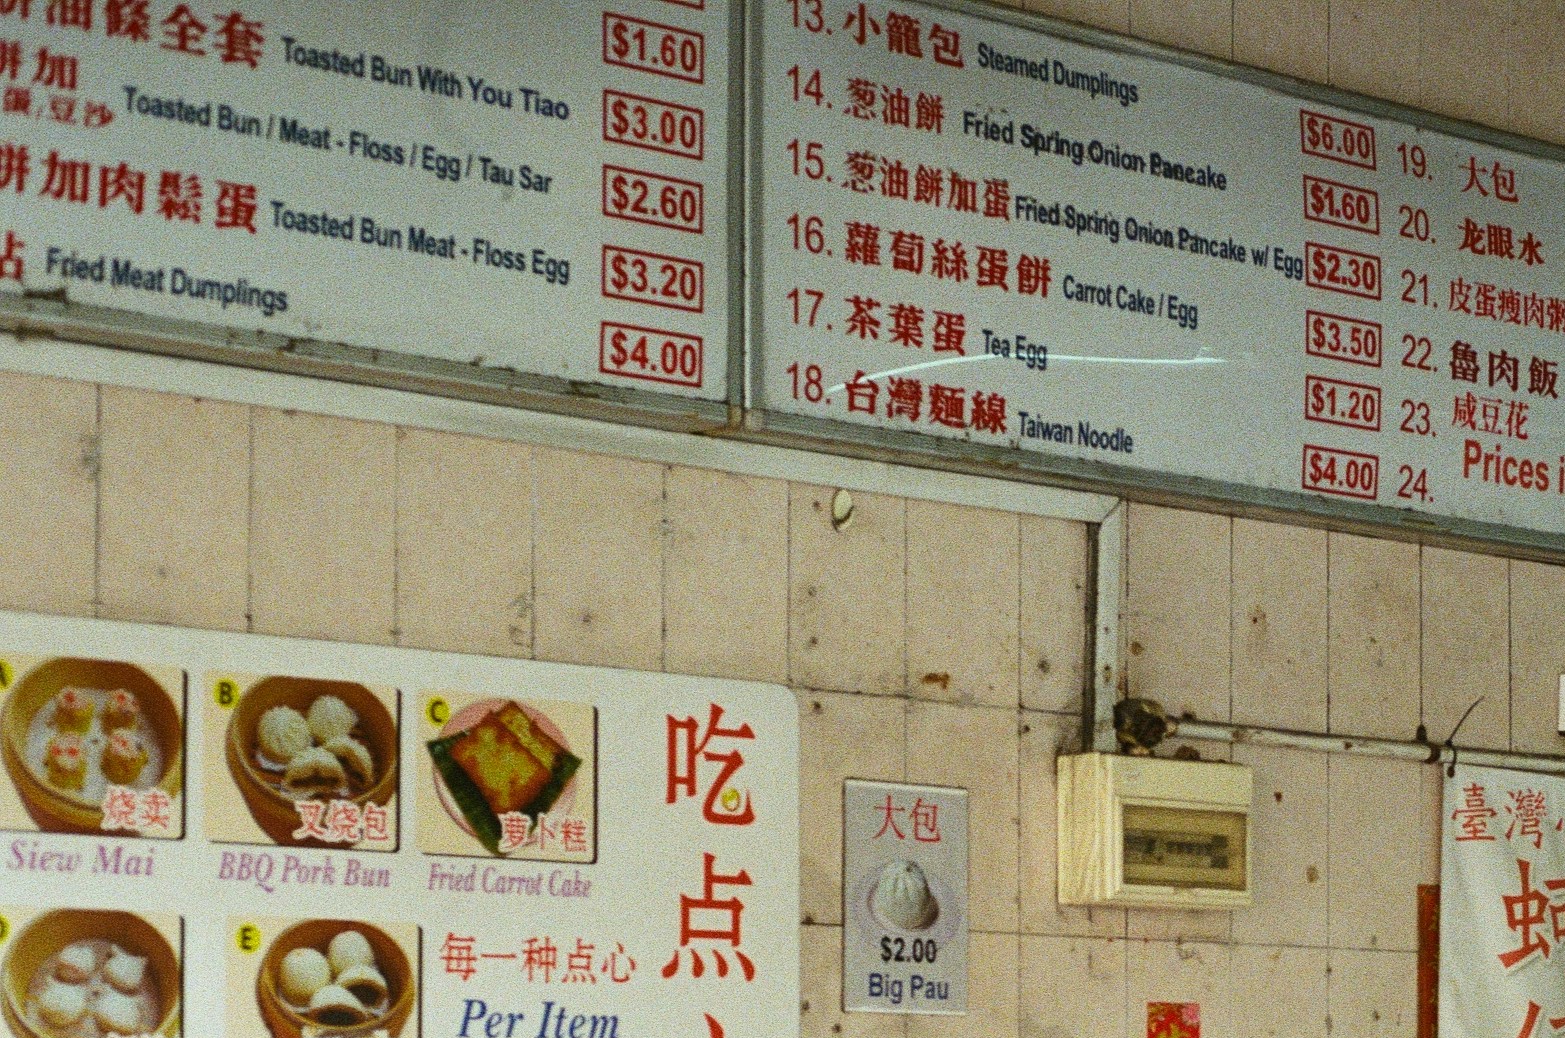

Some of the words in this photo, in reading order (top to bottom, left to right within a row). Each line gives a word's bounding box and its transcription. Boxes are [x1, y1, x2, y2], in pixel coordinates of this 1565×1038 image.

[610, 27, 698, 74] $1.60
[281, 36, 364, 78] Toasted
[371, 55, 412, 87] Bun
[416, 64, 463, 99] With
[467, 75, 512, 109] You
[519, 87, 570, 121] Tiao
[787, 65, 833, 110] 14.
[978, 42, 1048, 82] Steamed
[1053, 61, 1139, 105] Dumplings
[123, 85, 211, 127] Toasted
[217, 105, 261, 138] Bun
[279, 116, 331, 150] Meat
[349, 130, 404, 165] Floss
[422, 145, 461, 182] Egg
[477, 156, 513, 186] Tau
[519, 164, 553, 194] Sar
[610, 103, 698, 151] $3.00
[1307, 114, 1371, 161] $6.00
[787, 138, 833, 183] 15.
[964, 111, 1013, 146] Fried
[1020, 124, 1085, 165] Spring
[1088, 140, 1147, 173] Onion
[1150, 153, 1228, 190] Pancake
[1397, 142, 1432, 182] 19.
[610, 176, 698, 225] $2.60
[1311, 180, 1371, 225] $1.60
[1459, 156, 1519, 204] 大包
[270, 200, 354, 241] Toasted
[360, 217, 402, 249] Bun
[407, 225, 456, 259] Meat
[472, 237, 526, 272] Floss
[532, 249, 570, 286] Egg
[786, 213, 833, 258] 16.
[1015, 195, 1060, 226] Fried
[1064, 205, 1120, 244] Spring
[1124, 217, 1174, 248] Onion
[1178, 229, 1246, 263] Pancake
[1251, 243, 1270, 267] w/
[1274, 246, 1302, 280] Egg
[1400, 205, 1435, 244] 20.
[1457, 219, 1545, 266] 龙眼水
[46, 247, 105, 283] Fried
[111, 258, 164, 292] Meat
[170, 267, 289, 317] Dumplings
[610, 256, 698, 302] $3.20
[1312, 249, 1377, 294] $2.30
[1401, 270, 1438, 308] 21.
[786, 288, 833, 332] 17.
[1064, 275, 1111, 308] Carrot
[1115, 284, 1155, 315] Cake
[1168, 296, 1198, 330] Egg
[845, 296, 967, 356] 茶葉蛋
[1312, 319, 1377, 360] $3.50
[609, 331, 698, 380] $4.00
[982, 329, 1010, 359] Tea
[1016, 335, 1048, 371] Egg
[1401, 334, 1438, 372] 22.
[786, 363, 833, 406] 18.
[1311, 382, 1376, 425] $1.20
[1018, 412, 1073, 445] Taiwan
[1078, 422, 1133, 454] Noodle
[1400, 399, 1436, 437] 23.
[1451, 394, 1529, 440] 咸豆花
[1309, 451, 1374, 493] $4.00
[1397, 464, 1434, 502] 24.
[1463, 439, 1549, 491] Prices
[219, 682, 234, 704] B
[431, 701, 444, 723] C
[873, 794, 942, 843] 大包
[6, 839, 82, 873] Siew
[93, 843, 155, 876] Mai
[218, 851, 275, 893] BBQ
[282, 855, 335, 886] Pork
[344, 859, 391, 888] Bun
[428, 863, 475, 893] Fried
[482, 866, 542, 895] Carrot
[548, 869, 591, 898] Cake
[242, 927, 253, 950] E
[440, 932, 637, 984] 每一种点心
[880, 936, 937, 964] $2.00
[868, 972, 903, 1004] Big
[910, 975, 949, 1000] Pau
[457, 999, 523, 1038] Per
